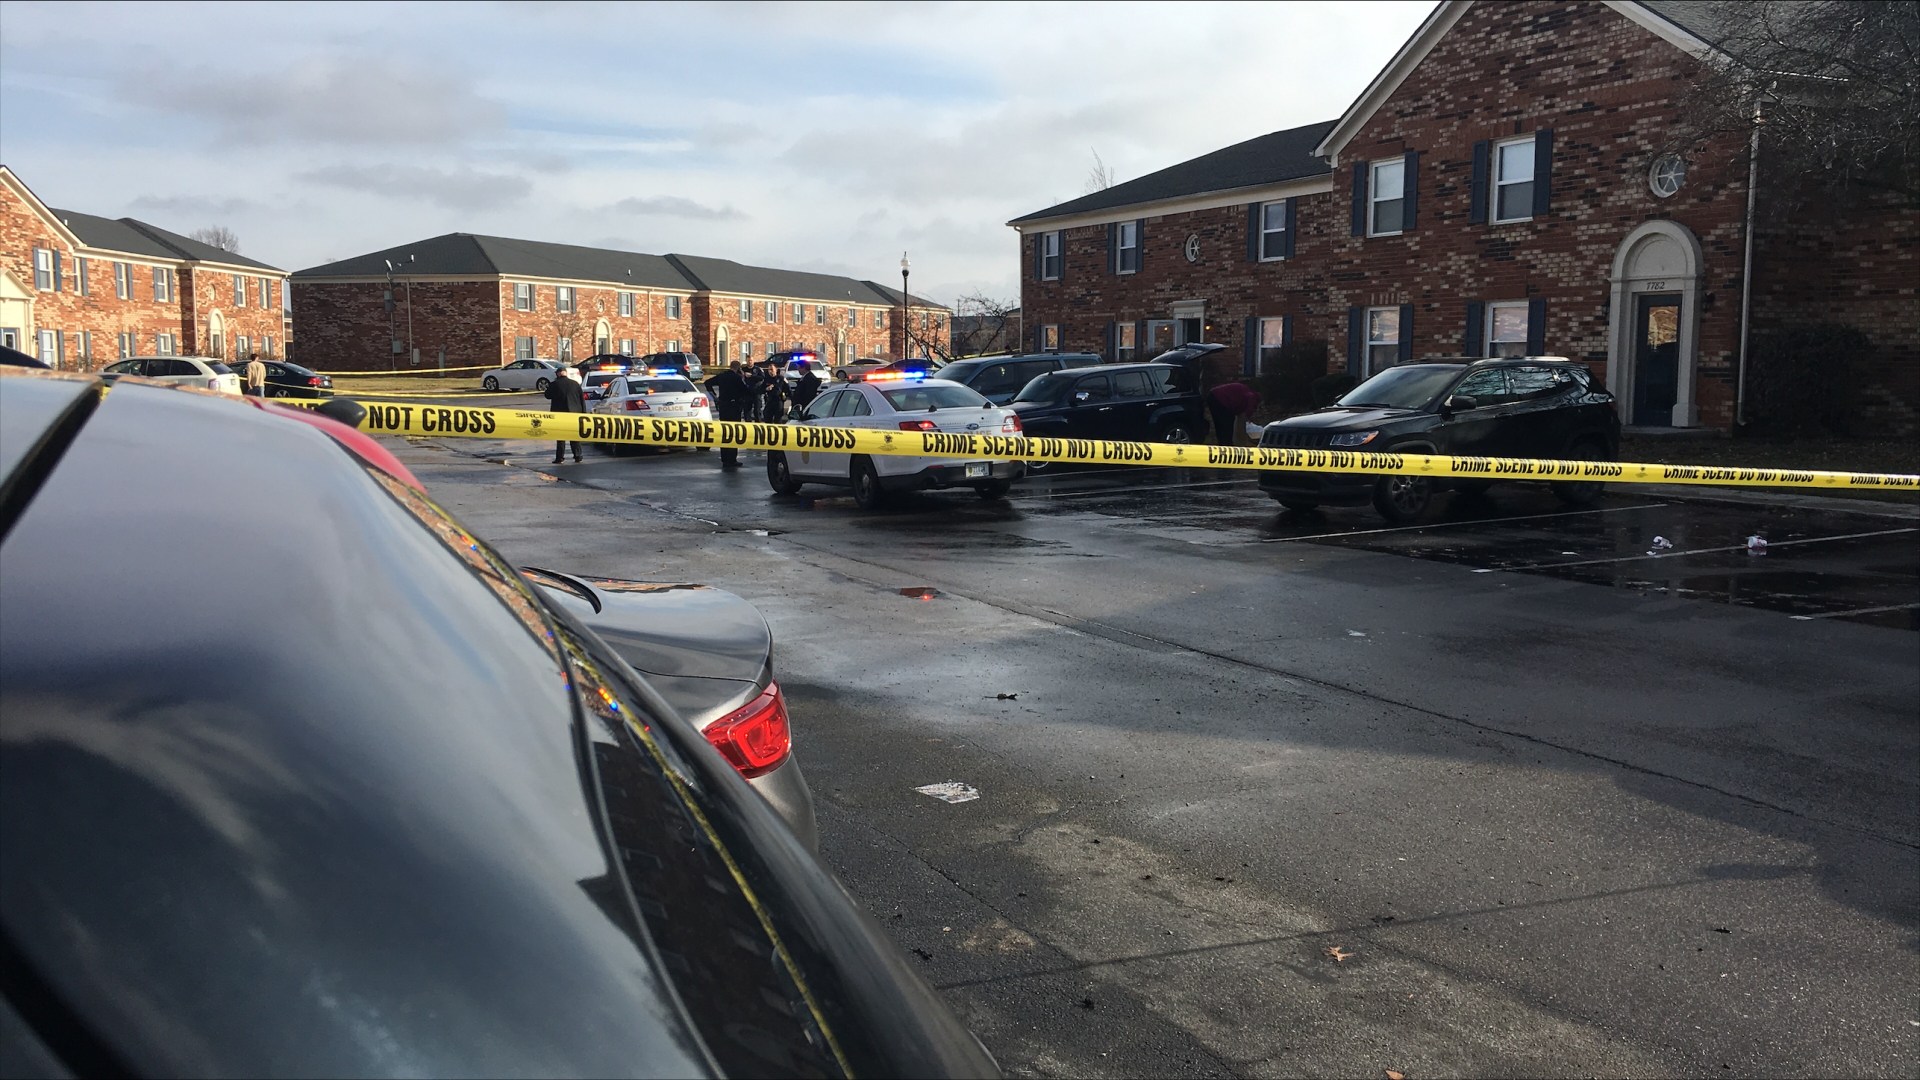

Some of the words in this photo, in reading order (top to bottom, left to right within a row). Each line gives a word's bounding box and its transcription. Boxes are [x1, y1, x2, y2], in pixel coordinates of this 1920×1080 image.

[368, 405, 414, 430] NOT
[422, 408, 496, 434] CROSS
[578, 416, 645, 440] CRIME
[652, 419, 714, 443] SCENE
[721, 423, 748, 445] DO
[753, 425, 789, 447] NOT
[796, 427, 856, 449] CROSS
[922, 433, 977, 454] CRIME
[982, 436, 1035, 456] SCENE
[1041, 439, 1062, 457] DO
[1067, 440, 1096, 459] NOT
[1102, 441, 1153, 461] CROSS
[1208, 446, 1254, 464] CRIME
[1259, 448, 1303, 466] SCENE
[1307, 450, 1326, 467] DO
[1330, 451, 1355, 468] NOT
[1360, 453, 1404, 469] CROSS
[1451, 457, 1492, 472] CRIME
[1495, 459, 1534, 473] SCENE
[1537, 461, 1554, 474] DO
[1557, 462, 1580, 475] NOT
[1584, 462, 1622, 476] CROSS
